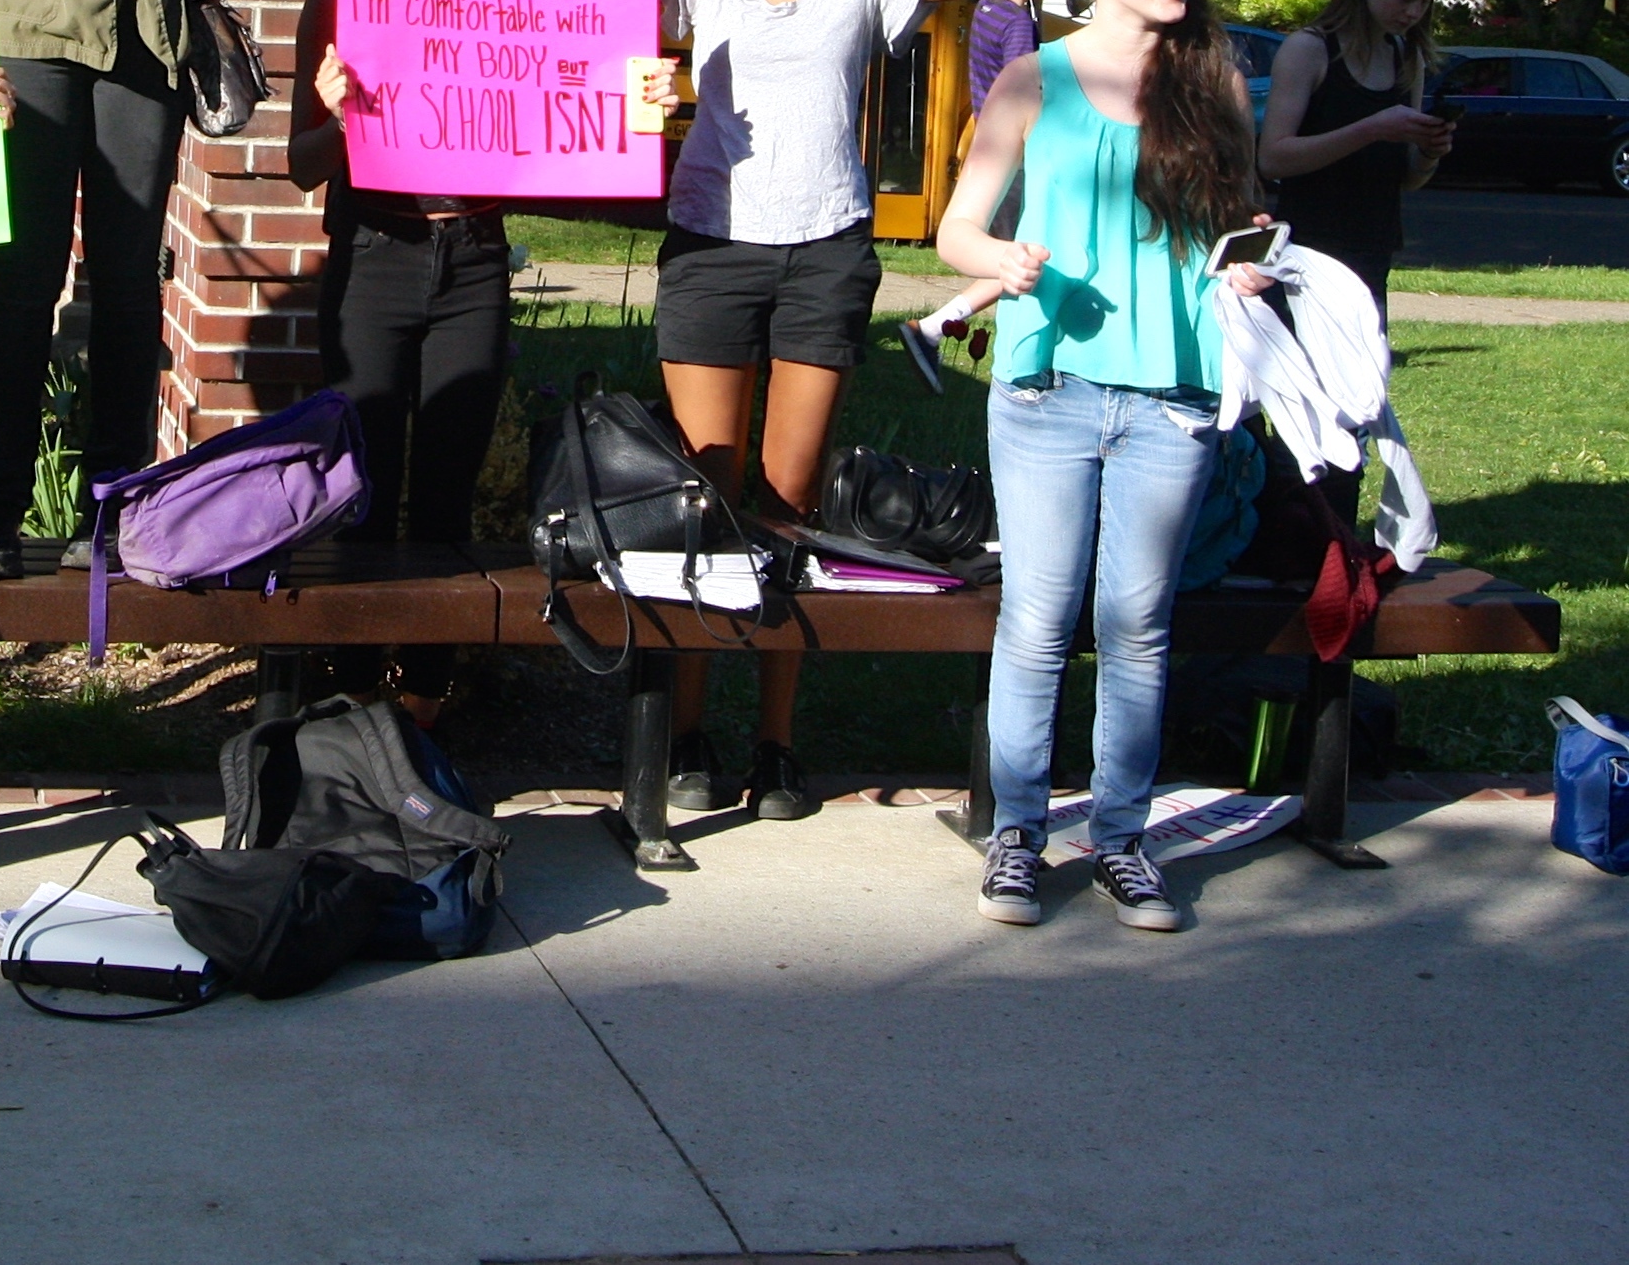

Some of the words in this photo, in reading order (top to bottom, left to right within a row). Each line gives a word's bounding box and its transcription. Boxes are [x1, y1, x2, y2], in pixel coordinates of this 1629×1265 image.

[555, 1, 606, 36] with
[422, 36, 463, 75] MY
[476, 40, 548, 87] BODY
[557, 59, 590, 76] BUT
[355, 82, 402, 150] MY
[418, 82, 532, 157] SCHOOL
